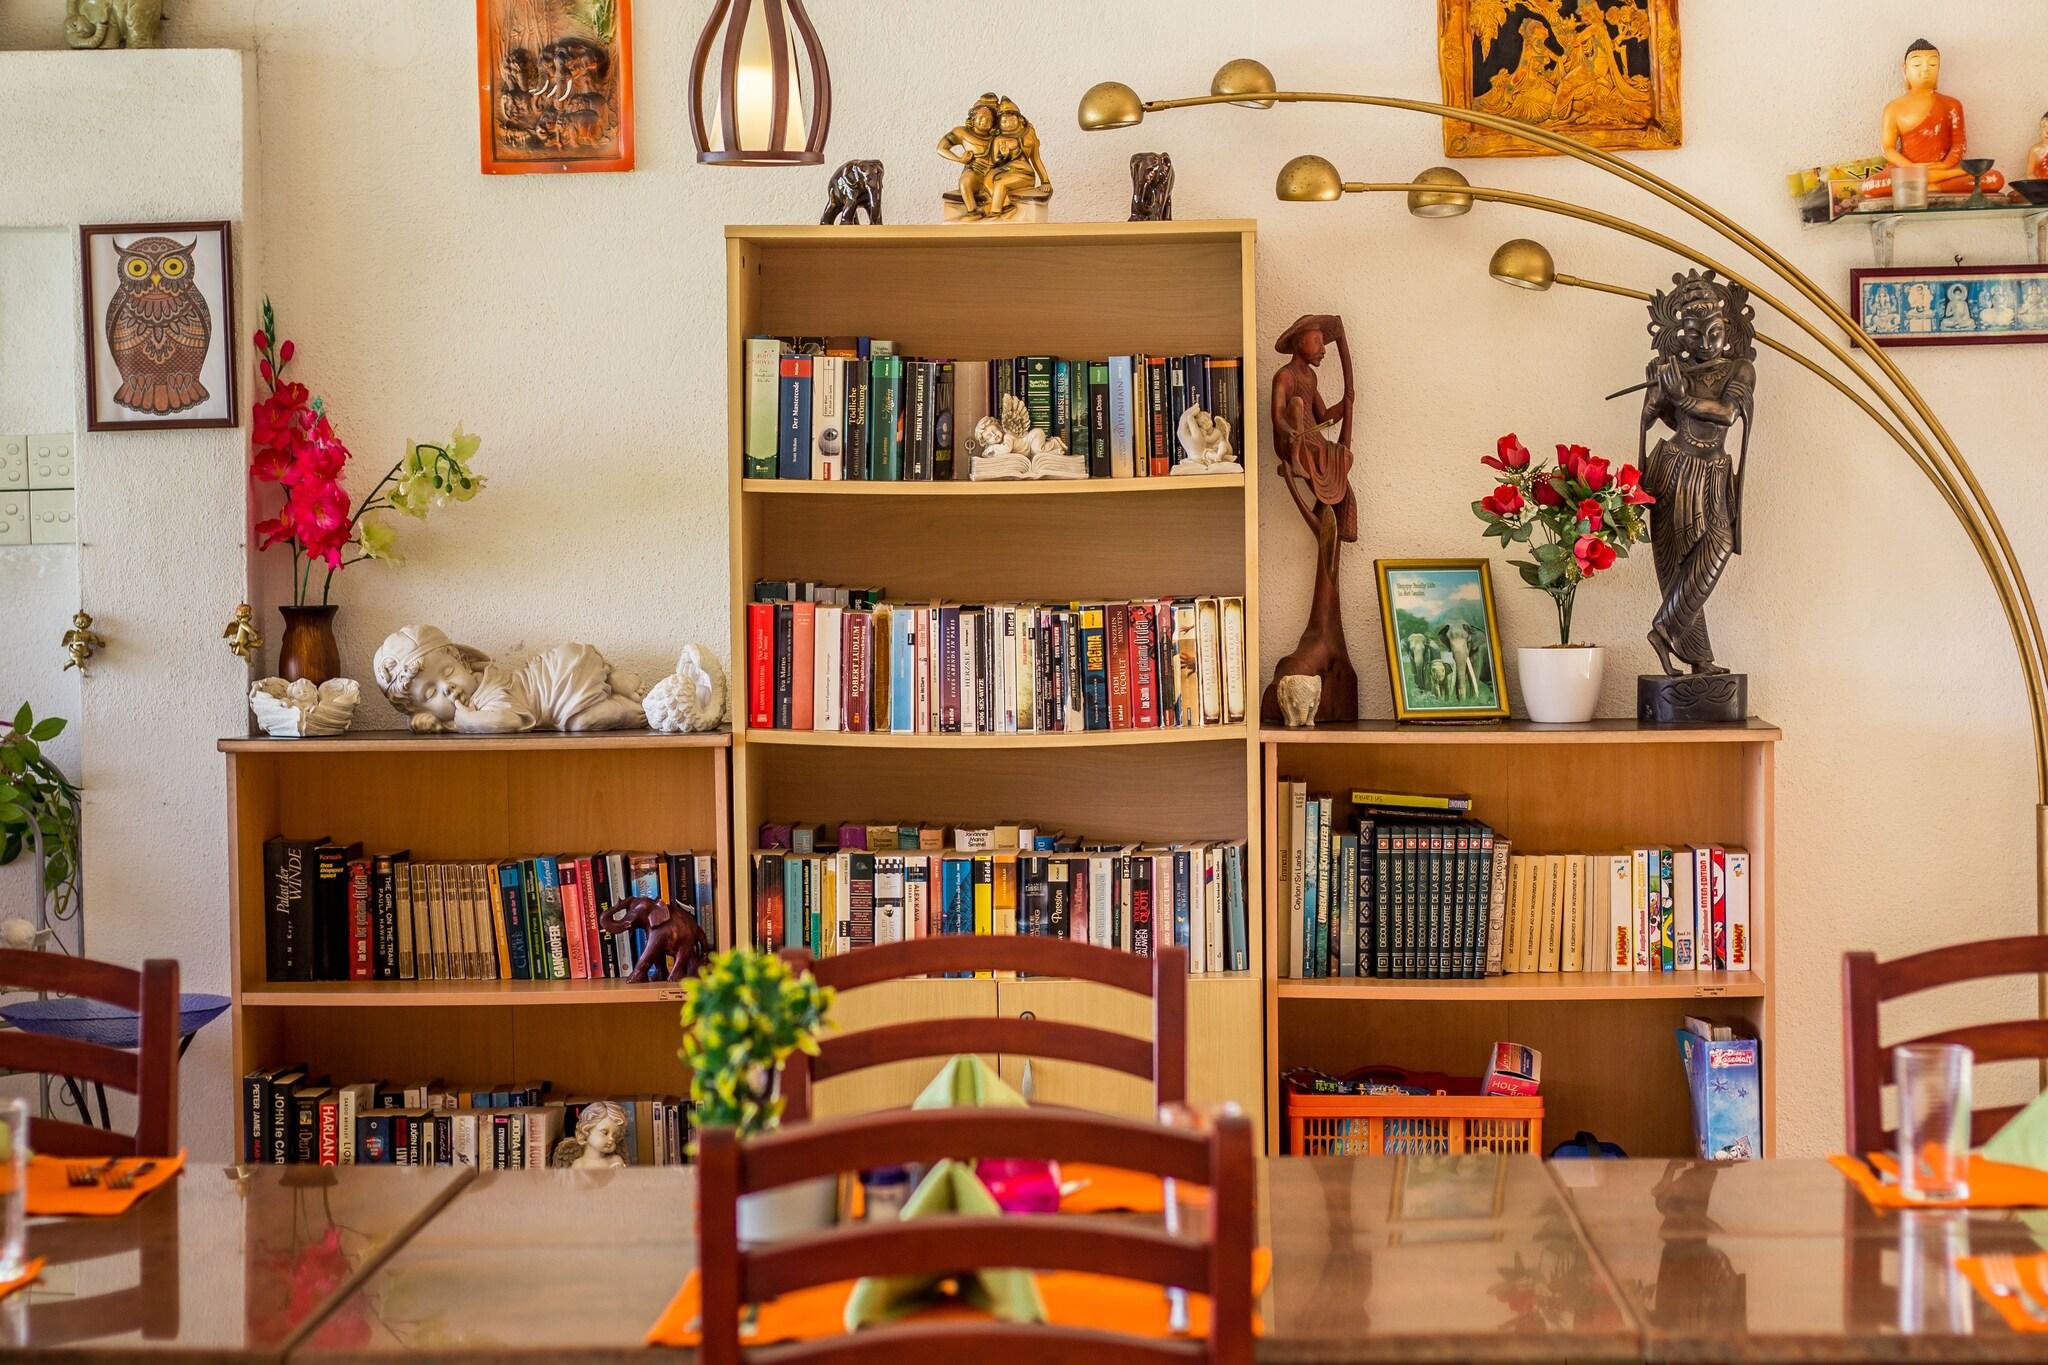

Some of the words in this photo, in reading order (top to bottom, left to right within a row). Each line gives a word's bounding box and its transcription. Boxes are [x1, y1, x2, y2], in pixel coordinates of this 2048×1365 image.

[1057, 372, 1065, 392] BLUES
[791, 381, 800, 416] Mastercode
[848, 387, 857, 424] Tödliche
[857, 384, 867, 424] Strömung
[1057, 393, 1065, 424] CHIEMSEE
[1095, 394, 1103, 411] Dosis
[791, 417, 799, 429] Der
[1007, 613, 1015, 636] PIPER
[1133, 619, 1149, 644] Orden
[852, 626, 860, 660] LUDLUM
[1111, 617, 1119, 656] NEUNZEHN
[852, 661, 860, 697] ROBERT
[1118, 658, 1127, 694] PICOULT
[1137, 674, 1149, 684] Der
[1140, 687, 1149, 701] Smith
[1318, 826, 1328, 869] SCHWEIZER
[1294, 849, 1302, 871] Lanka
[1482, 859, 1490, 881] SUISSE
[275, 865, 289, 883] der
[288, 847, 302, 900] WINDE
[1700, 860, 1708, 908] ENTEN-EDITION
[352, 875, 368, 899] Orden
[1317, 869, 1328, 923] UNBEKANNTE
[1380, 882, 1387, 893] LA
[1395, 883, 1402, 893] LA
[1408, 882, 1415, 892] LA
[1419, 882, 1426, 892] LA
[1431, 882, 1438, 892] LA
[1444, 883, 1451, 893] LA
[1457, 883, 1464, 892] LA
[1469, 883, 1476, 892] LA
[1482, 883, 1489, 892] LA
[275, 884, 290, 914] Palast
[1051, 889, 1063, 924] Passion
[1140, 890, 1150, 923] QUOTE
[1380, 893, 1387, 903] DE
[1395, 894, 1402, 903] DE
[1408, 893, 1414, 903] DE
[1419, 894, 1426, 903] DE
[1431, 894, 1438, 903] DE
[1443, 894, 1450, 903] DE
[1457, 893, 1463, 903] DE
[1469, 893, 1475, 903] DE
[1481, 893, 1488, 903] DE
[386, 913, 393, 924] ON
[355, 927, 367, 937] Der
[515, 930, 527, 969] CLARE
[548, 925, 565, 978] GANGHOFER
[252, 1083, 260, 1109] PETER
[1491, 1080, 1520, 1092] HOLZ
[274, 1092, 285, 1125] JOHN
[253, 1111, 261, 1137] JAMES
[275, 1127, 285, 1138] le
[322, 1106, 335, 1156] HARLAN
[410, 1123, 419, 1145] BJÖRN
[530, 1118, 541, 1142] DEAN
